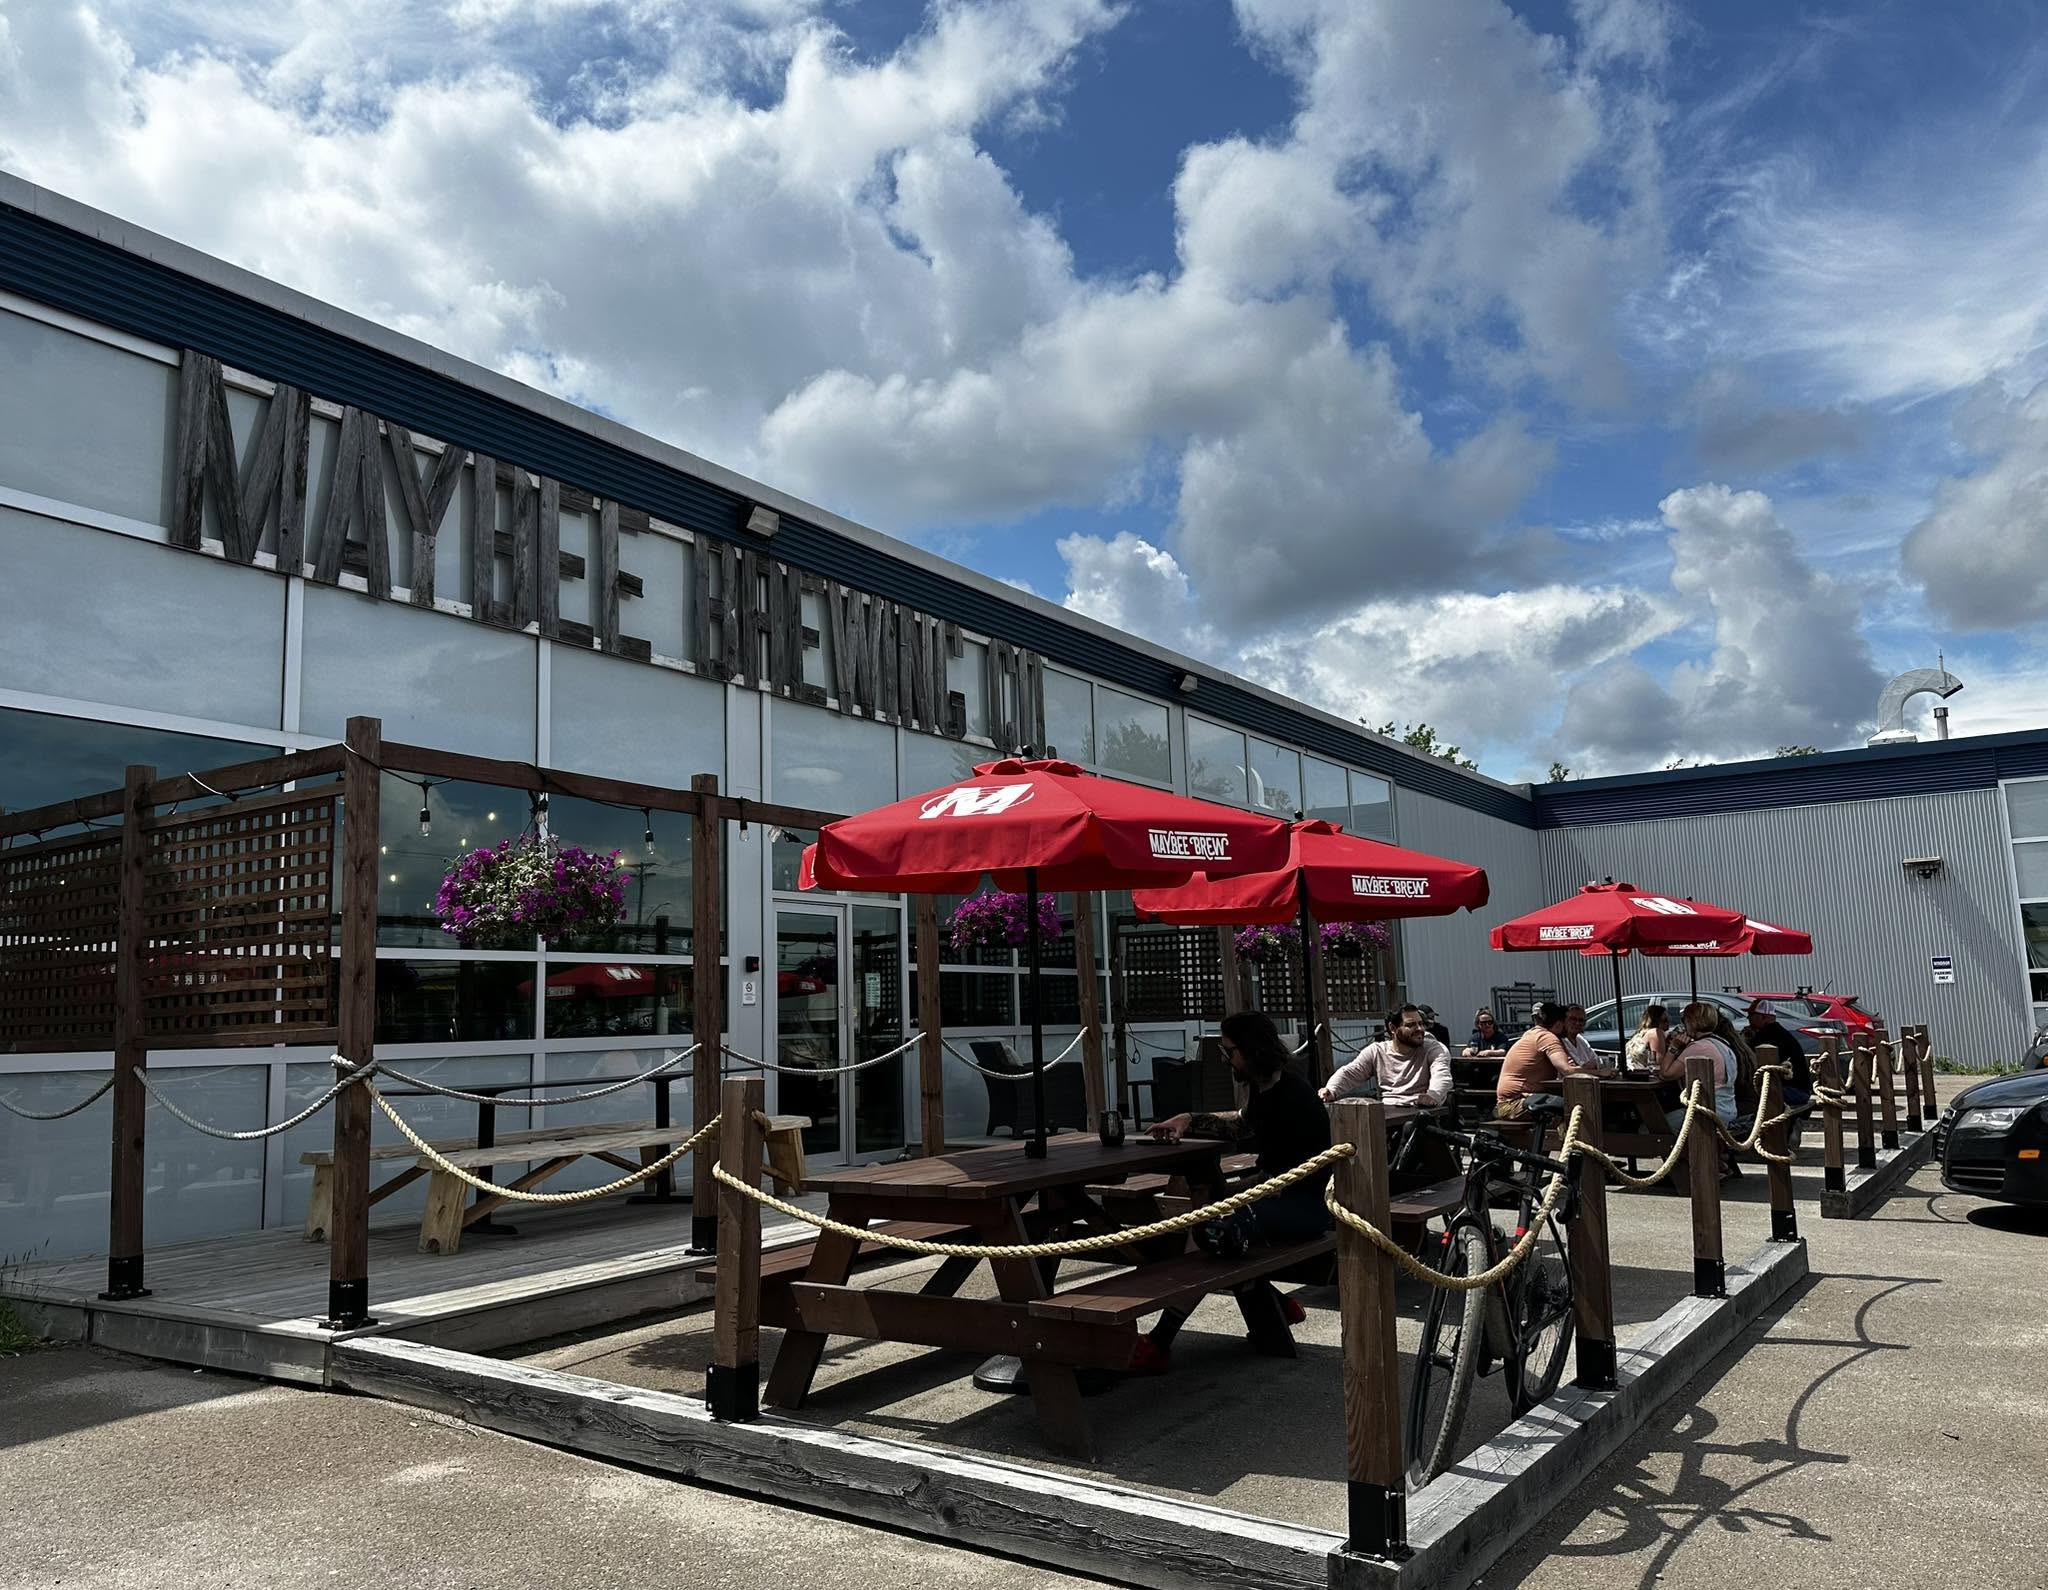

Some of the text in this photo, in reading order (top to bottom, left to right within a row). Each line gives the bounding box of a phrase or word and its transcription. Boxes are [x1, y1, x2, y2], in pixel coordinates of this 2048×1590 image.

[170, 347, 652, 662] MAYBEE
[692, 531, 968, 741] BREWING
[1148, 830, 1229, 860] MAYBEE BREW
[1351, 876, 1429, 898] MAYBEE BREW
[1541, 926, 1594, 940] MAYBEE BREW
